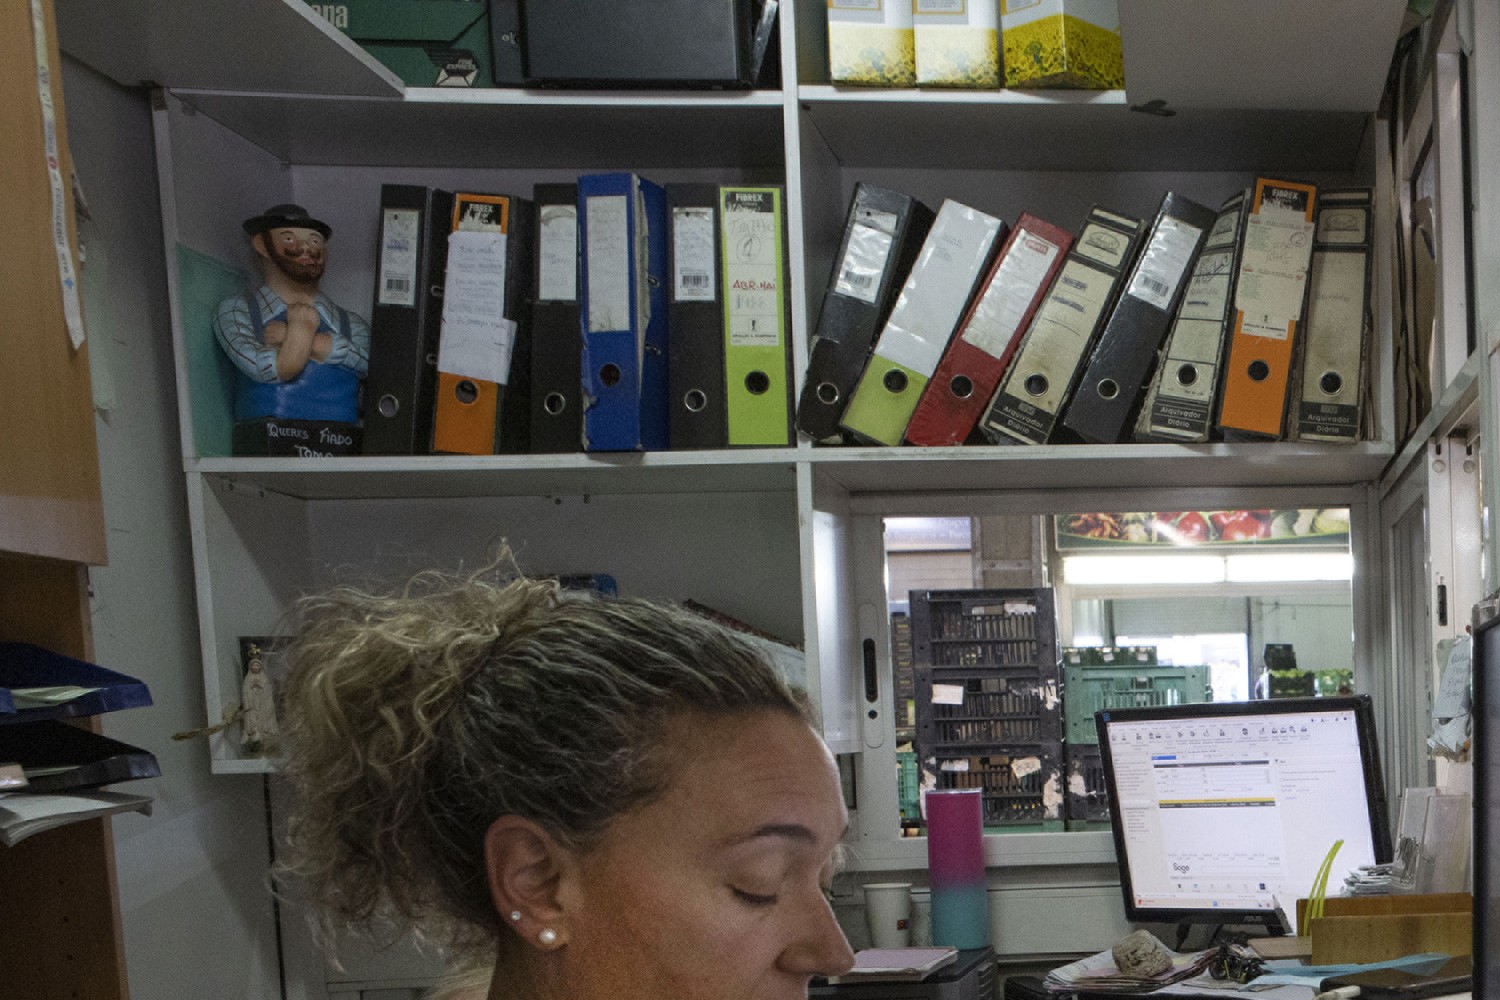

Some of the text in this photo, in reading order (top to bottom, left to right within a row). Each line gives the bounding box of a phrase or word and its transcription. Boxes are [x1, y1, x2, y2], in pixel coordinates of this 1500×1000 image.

[736, 193, 763, 202] FIBREX
[1272, 188, 1299, 200] FIBREX
[469, 203, 494, 213] FIBREX
[1002, 406, 1045, 429] Arquivador
[1160, 405, 1202, 419] Arquivador
[1167, 418, 1191, 429] Diário
[1307, 413, 1351, 424] Arquivador
[268, 423, 310, 440] QUERES
[1007, 418, 1030, 435] Diário
[1316, 425, 1340, 434] Diário
